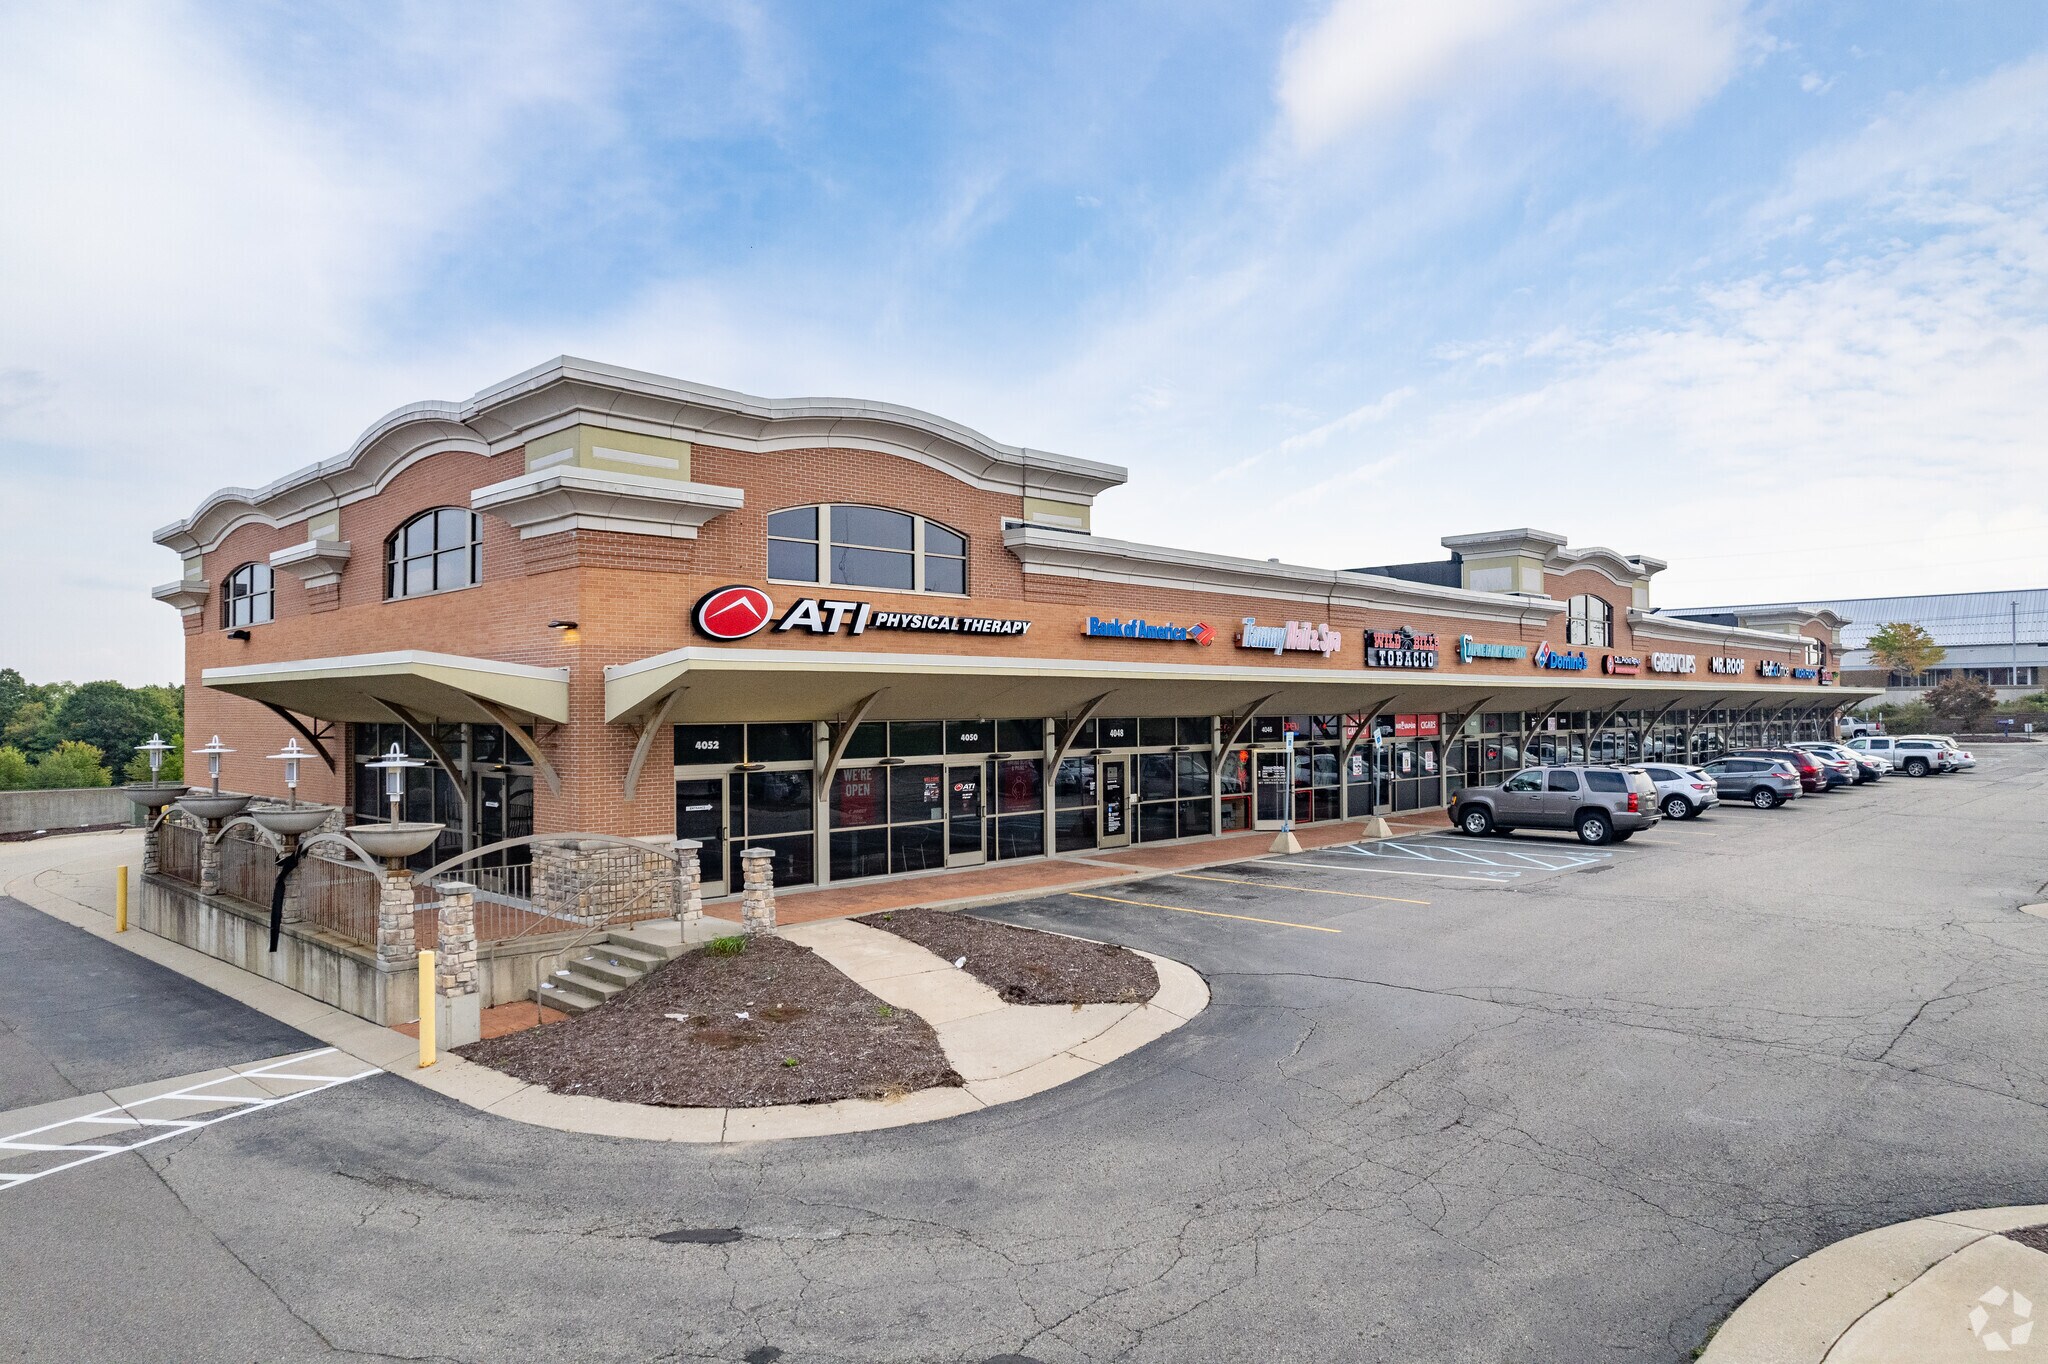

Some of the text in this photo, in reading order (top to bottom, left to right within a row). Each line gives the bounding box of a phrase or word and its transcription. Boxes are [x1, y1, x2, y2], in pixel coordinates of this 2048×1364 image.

[778, 598, 1032, 634] ATI PHYSICAL THERAPY
[1087, 616, 1187, 641] Bank of America
[1319, 623, 1342, 657] Spa
[1373, 632, 1401, 649] WILD
[1379, 650, 1434, 667] TOBACCO
[1548, 651, 1588, 670] Domino's
[1653, 652, 1679, 672] GREAT
[1678, 654, 1696, 674] CLIPS
[1712, 656, 1745, 674] MR. ROOF
[1420, 720, 1437, 729] CIGARS
[695, 741, 720, 750] 4052
[960, 733, 979, 741] 4050
[843, 768, 873, 781] WE'RE
[845, 783, 871, 797] OPEN
